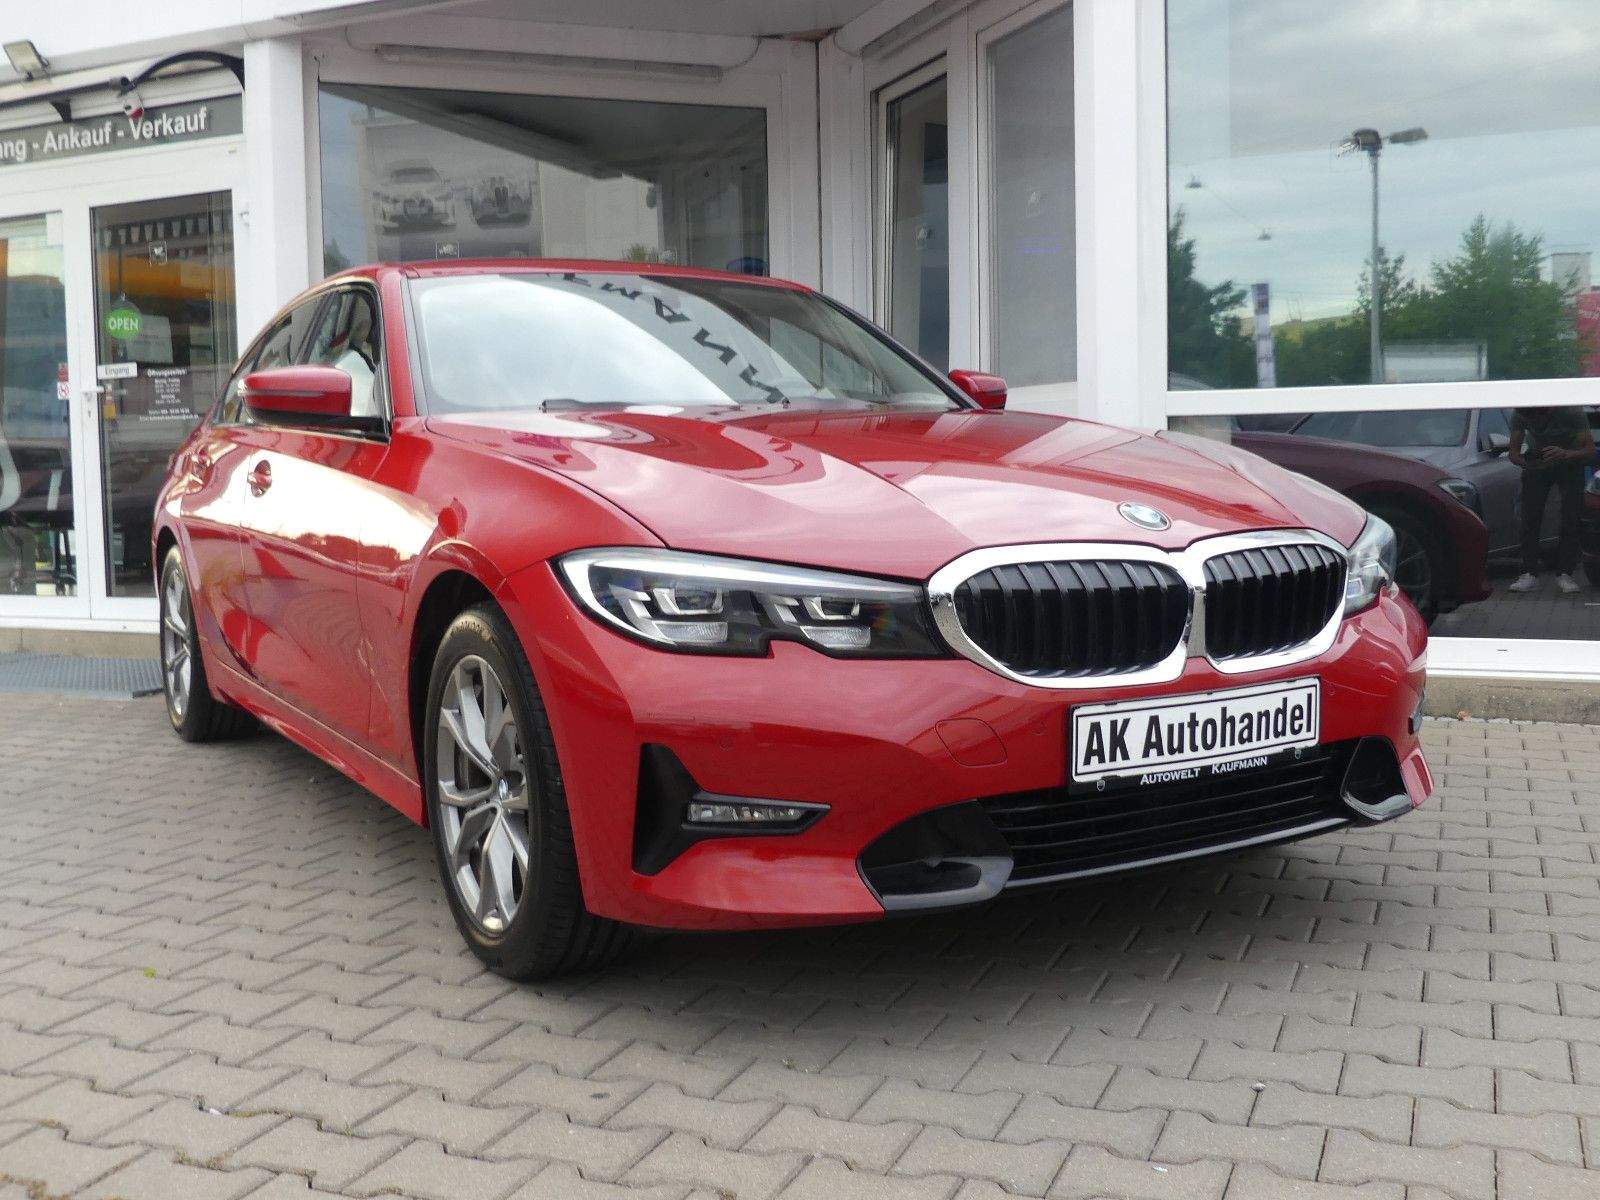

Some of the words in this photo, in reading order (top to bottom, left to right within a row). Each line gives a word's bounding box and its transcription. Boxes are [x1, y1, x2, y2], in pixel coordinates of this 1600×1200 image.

[43, 119, 113, 153] Ankauf
[128, 105, 207, 140] Verkauf
[108, 316, 139, 331] OPEN
[1082, 717, 1131, 767] AK
[1141, 692, 1313, 759] Autohandel
[1140, 767, 1200, 785] AUTOWELT
[1211, 756, 1268, 774] KAUFMANN
